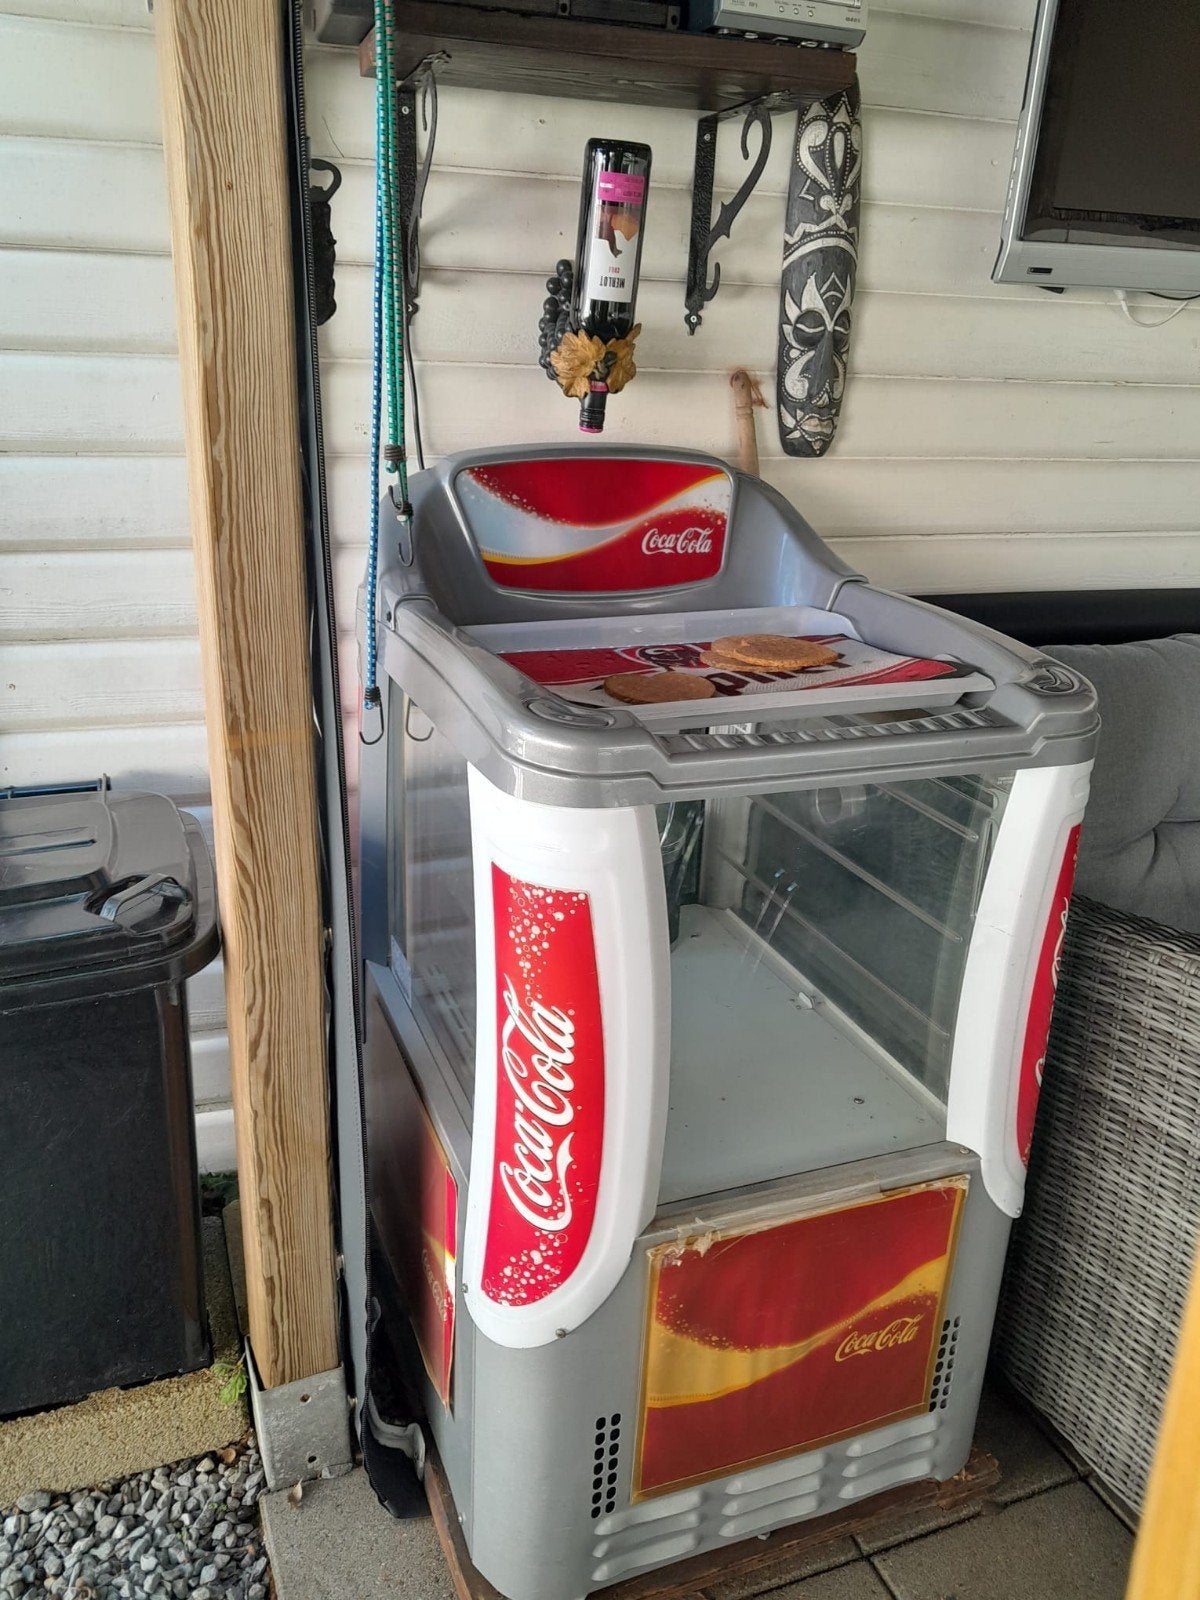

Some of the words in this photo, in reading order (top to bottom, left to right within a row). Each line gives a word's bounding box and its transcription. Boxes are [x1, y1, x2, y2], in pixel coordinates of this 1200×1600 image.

[599, 276, 626, 289] MERLOT
[641, 527, 715, 555] Coca-Cola
[499, 972, 577, 1234] Coca-Cola
[834, 1312, 926, 1363] Coca-Cola
